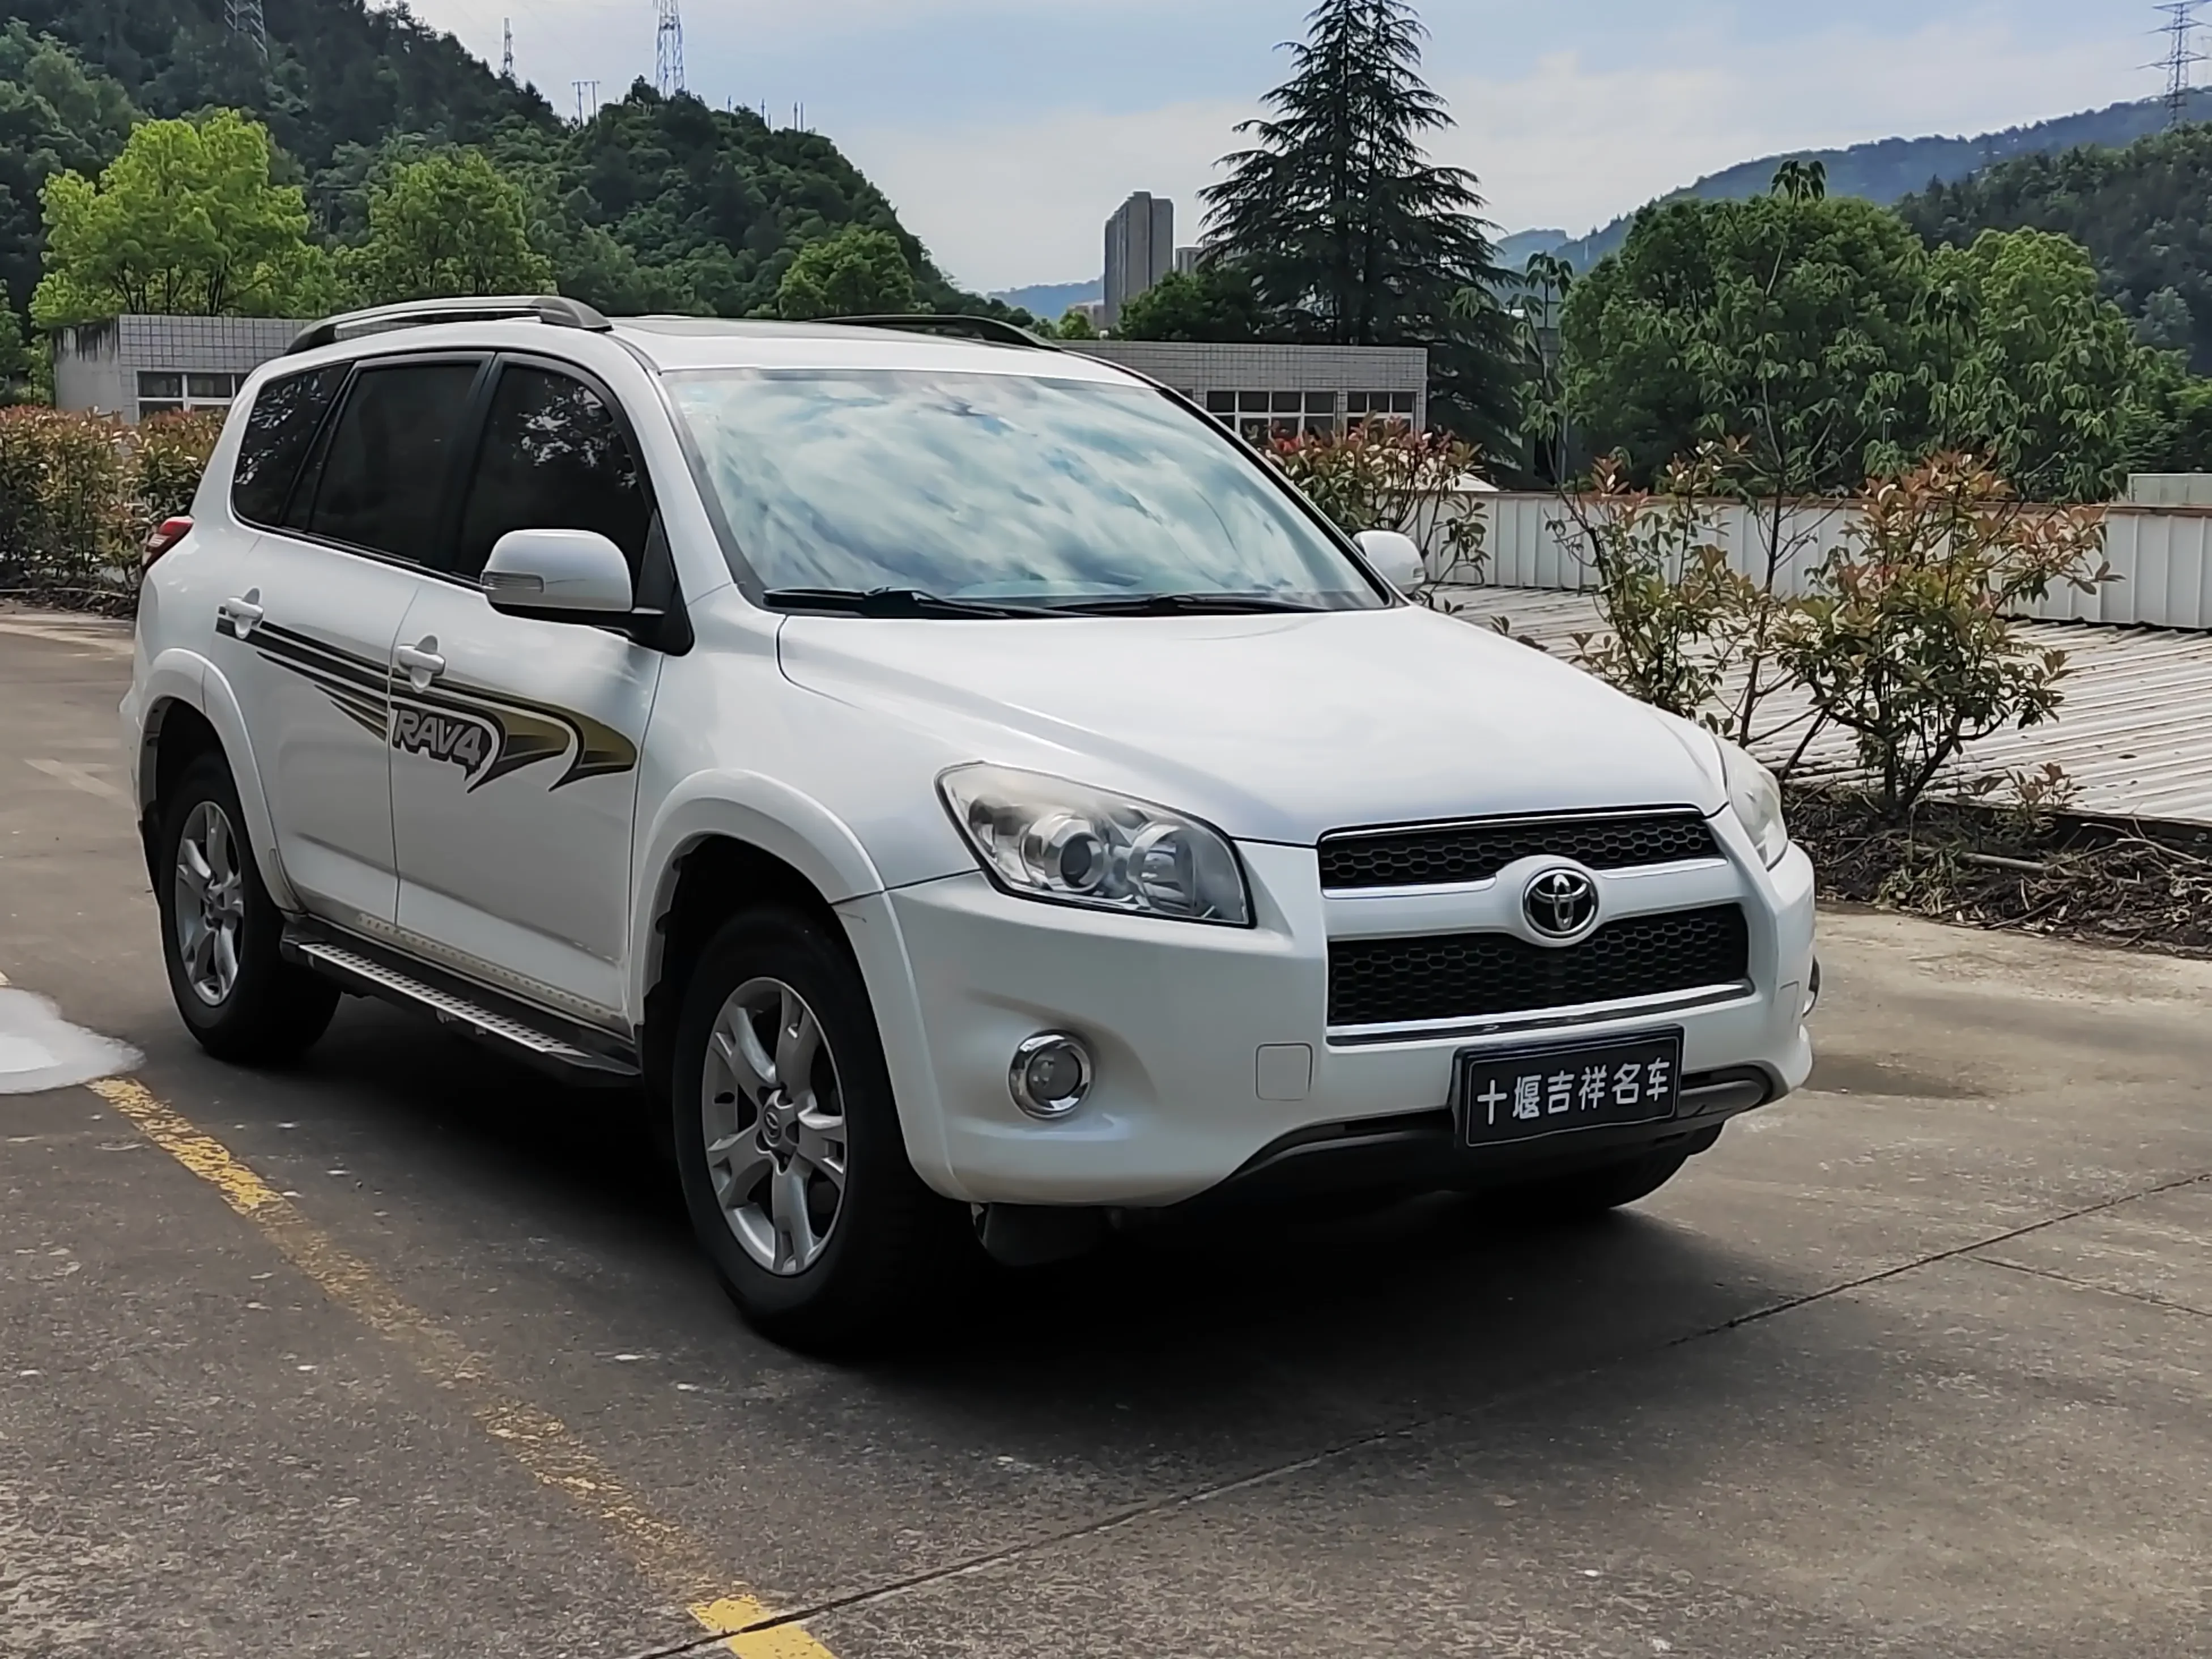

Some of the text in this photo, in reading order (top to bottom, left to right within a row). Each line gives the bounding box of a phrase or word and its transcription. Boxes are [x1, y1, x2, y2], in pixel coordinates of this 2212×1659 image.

[393, 708, 483, 768] RAV4
[1476, 1057, 1671, 1125] 十堰吉祥名车
